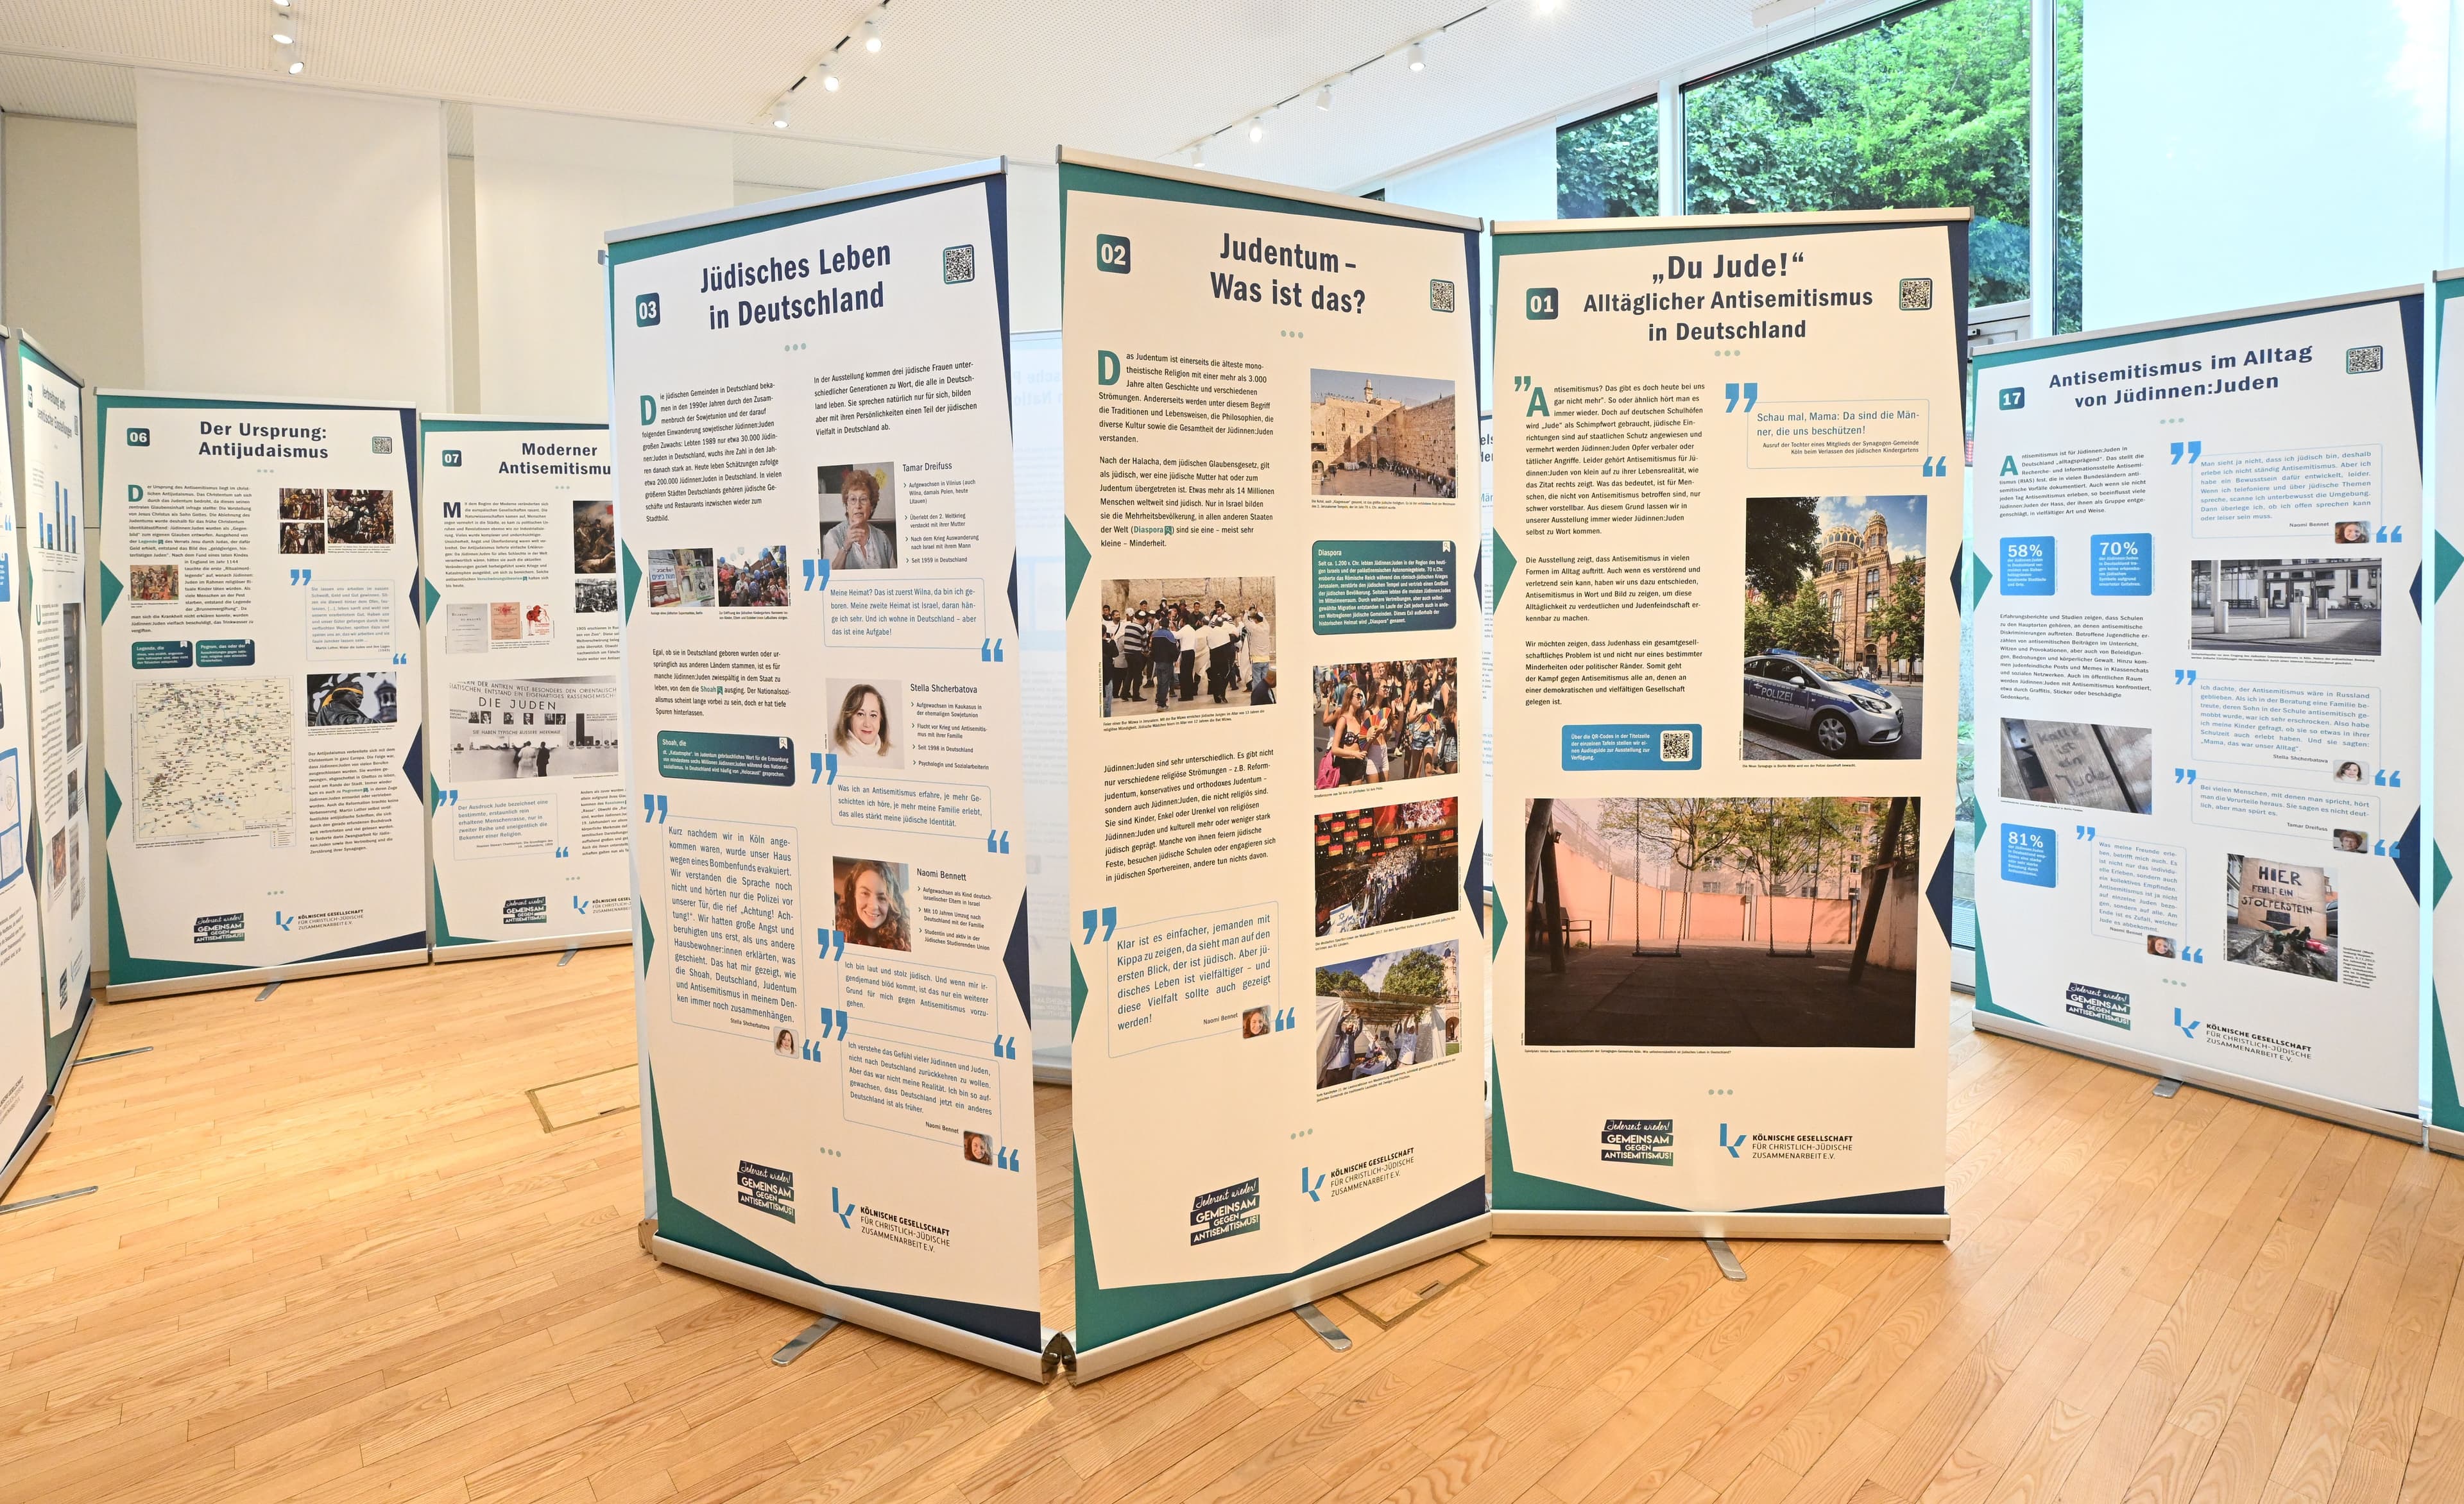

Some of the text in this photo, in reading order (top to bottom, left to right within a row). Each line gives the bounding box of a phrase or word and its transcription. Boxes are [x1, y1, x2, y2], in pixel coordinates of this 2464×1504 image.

[1100, 244, 1126, 266] 02
[1220, 233, 1338, 273] Judentum
[701, 246, 890, 293] Jüdisches Leben
[1210, 272, 1365, 314] Was ist das?
[1584, 289, 1872, 315] Alltäglicher Antisemitismus
[639, 301, 657, 320] 03
[710, 282, 883, 330] in Deutschland
[1530, 296, 1553, 312] 01
[1649, 320, 1805, 341] in Deutschland
[832, 373, 864, 381] Ausstellung
[905, 366, 930, 375] jüdische
[1127, 366, 1162, 375] theistische
[1165, 369, 1189, 378] Religion
[2049, 346, 2313, 388] Antisemitismus im Alltag
[2003, 392, 2021, 406] 17
[2075, 376, 2278, 407] von Jüdinnen:Juden
[130, 432, 147, 443] 06
[201, 422, 326, 441] Der Ursprung:
[1812, 426, 1865, 435] beschützen!
[199, 442, 328, 459] Antijudaismus
[445, 454, 459, 463] 07
[522, 443, 597, 456] Moderner
[499, 461, 610, 474] Antisemitismu
[925, 462, 952, 470] Dreifuss
[2008, 544, 2042, 559] 58%
[2100, 542, 2137, 555] 70%
[911, 683, 977, 693] Stella Shcherbatova
[1761, 687, 1793, 702] POLIZEI
[479, 697, 555, 710] DIE JUDEN
[669, 826, 682, 835] Kurz
[688, 830, 717, 839] nachdem
[750, 834, 764, 844] Köln
[771, 839, 790, 848] ange-
[2008, 832, 2043, 848] 81%
[917, 868, 966, 881] Naomi Bennett
[2259, 866, 2302, 886] HIER
[2252, 885, 2293, 896] FEHLT EIN
[2241, 896, 2313, 914] STOLPERSTEIN
[298, 921, 344, 930] ZUSAMMENARBEIT
[309, 914, 364, 923] CHRISTLICH-JÜDISCHE
[2071, 984, 2127, 1002] Jederzeit wieder!
[2071, 994, 2126, 1013] GEMEINSAM
[2086, 1005, 2110, 1014] GEGEN
[1118, 1014, 1151, 1030] werden!
[2069, 1006, 2129, 1025] ANTISEMITISMUS!
[2206, 1023, 2312, 1052] KÖLNISCHE GESELLSCHAFT
[2223, 1034, 2312, 1059] CHRISTLICH-JÜDISCHE
[2207, 1038, 2278, 1059] ZUSAMMENARBEIT
[1607, 1120, 1670, 1131] Jederzeit wieder!
[1607, 1134, 1670, 1144] GEMEINSAM
[741, 1161, 791, 1183] Jederzeit wieder!
[1331, 1147, 1414, 1178] KÖLNISCHE GESELLSCHAFT
[1331, 1157, 1414, 1188] FÜR CHRISTLICH-JÜDISCHE
[741, 1177, 791, 1198] GEMEINSAM
[1195, 1181, 1256, 1208] Jederzeit wieder!
[1331, 1174, 1389, 1197] ZUSAMMENARBEIT
[740, 1195, 794, 1216] ANTISEMITISMUS!
[756, 1191, 777, 1202] GEGEN
[1196, 1197, 1256, 1223] GEMEINSAM
[1213, 1213, 1239, 1226] GEGEN
[860, 1206, 950, 1236] KÖLNISCHE GESELLSCHAFT
[1194, 1215, 1258, 1242] ANTISEMITISMUS!
[860, 1216, 950, 1247] FÜR CHRISTLICH-JÜDISCHE
[861, 1226, 935, 1252] ZUSAMMENARBEIT E.V.
